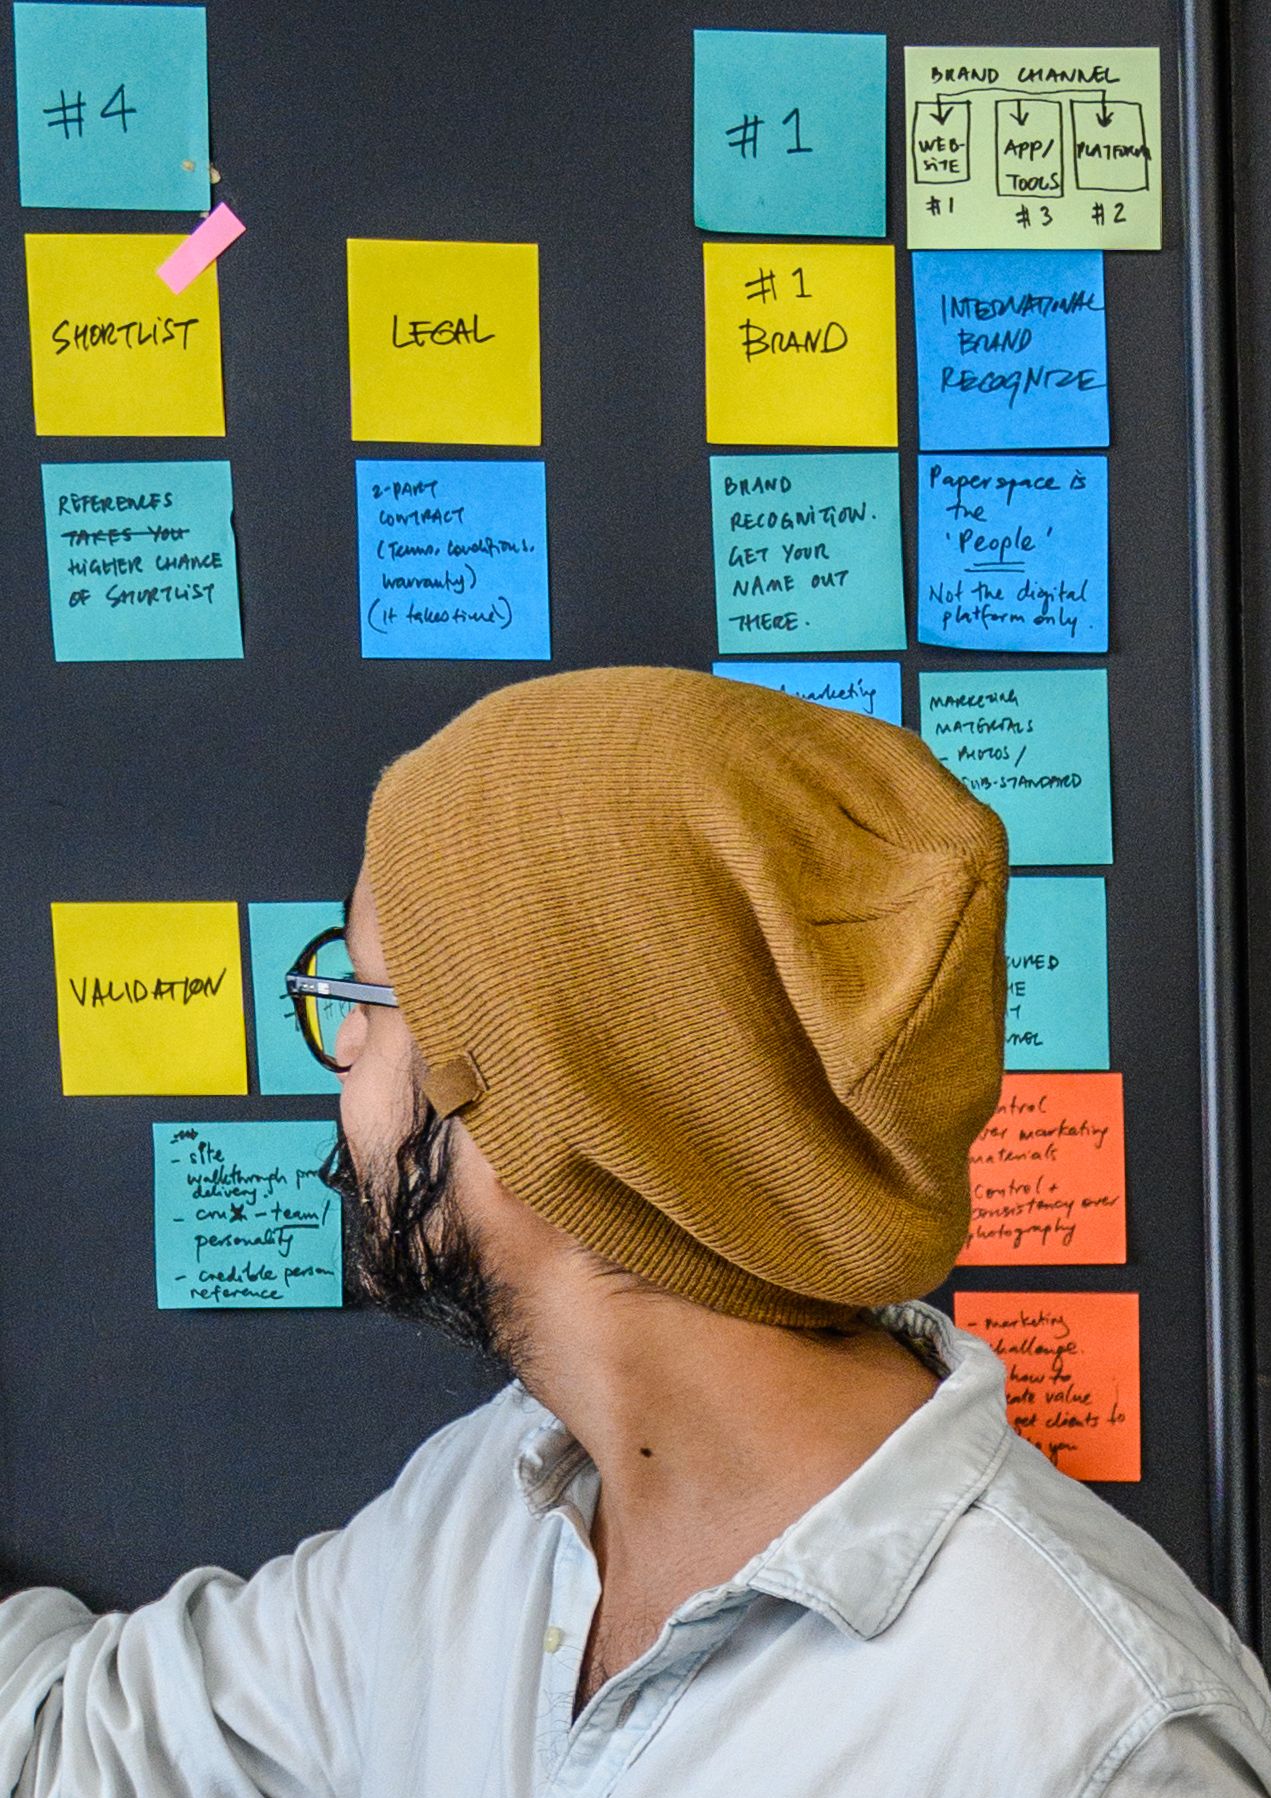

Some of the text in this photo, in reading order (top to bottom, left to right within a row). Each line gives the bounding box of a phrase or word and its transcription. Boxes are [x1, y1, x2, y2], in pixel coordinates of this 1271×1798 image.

[931, 65, 1120, 84] BRAND CHANNEL
[919, 135, 965, 153] WEB-
[1077, 142, 1152, 161] PLATFORM
[1005, 172, 1060, 192] TOOLS
[52, 316, 199, 354] SHORTLIST
[392, 314, 495, 348] LEGAL
[738, 318, 848, 363] BRAND
[957, 328, 1033, 356] BRAND
[941, 365, 1107, 409] RECOGNIZE
[372, 480, 439, 499] 2-PART
[724, 476, 792, 497] BRAND
[1069, 469, 1087, 490] is
[58, 492, 173, 515] REFERENCES
[946, 502, 987, 522] the
[378, 507, 464, 526] CONTRACT
[730, 502, 877, 532] RECOGNITION.
[68, 552, 223, 577] HIGHER CHANCE
[729, 543, 830, 567] GET YOUR
[733, 569, 849, 597] NAME OUT
[69, 587, 91, 608] OF
[929, 578, 1088, 615] Not the digital
[943, 604, 1025, 631] platform
[935, 717, 1034, 736] MATERIALS
[69, 967, 227, 1009] VALIDATION
[1019, 1118, 1109, 1150] marketing
[190, 1142, 225, 1166] site
[974, 1175, 1044, 1199] Control
[1081, 1195, 1120, 1208] over
[194, 1227, 293, 1263] personality
[199, 1261, 278, 1283] credible
[190, 1285, 284, 1303] reference
[985, 1310, 1071, 1340] marketing
[1046, 1384, 1092, 1406] value
[1045, 1411, 1099, 1429] clients
[1107, 1403, 1126, 1425] to
